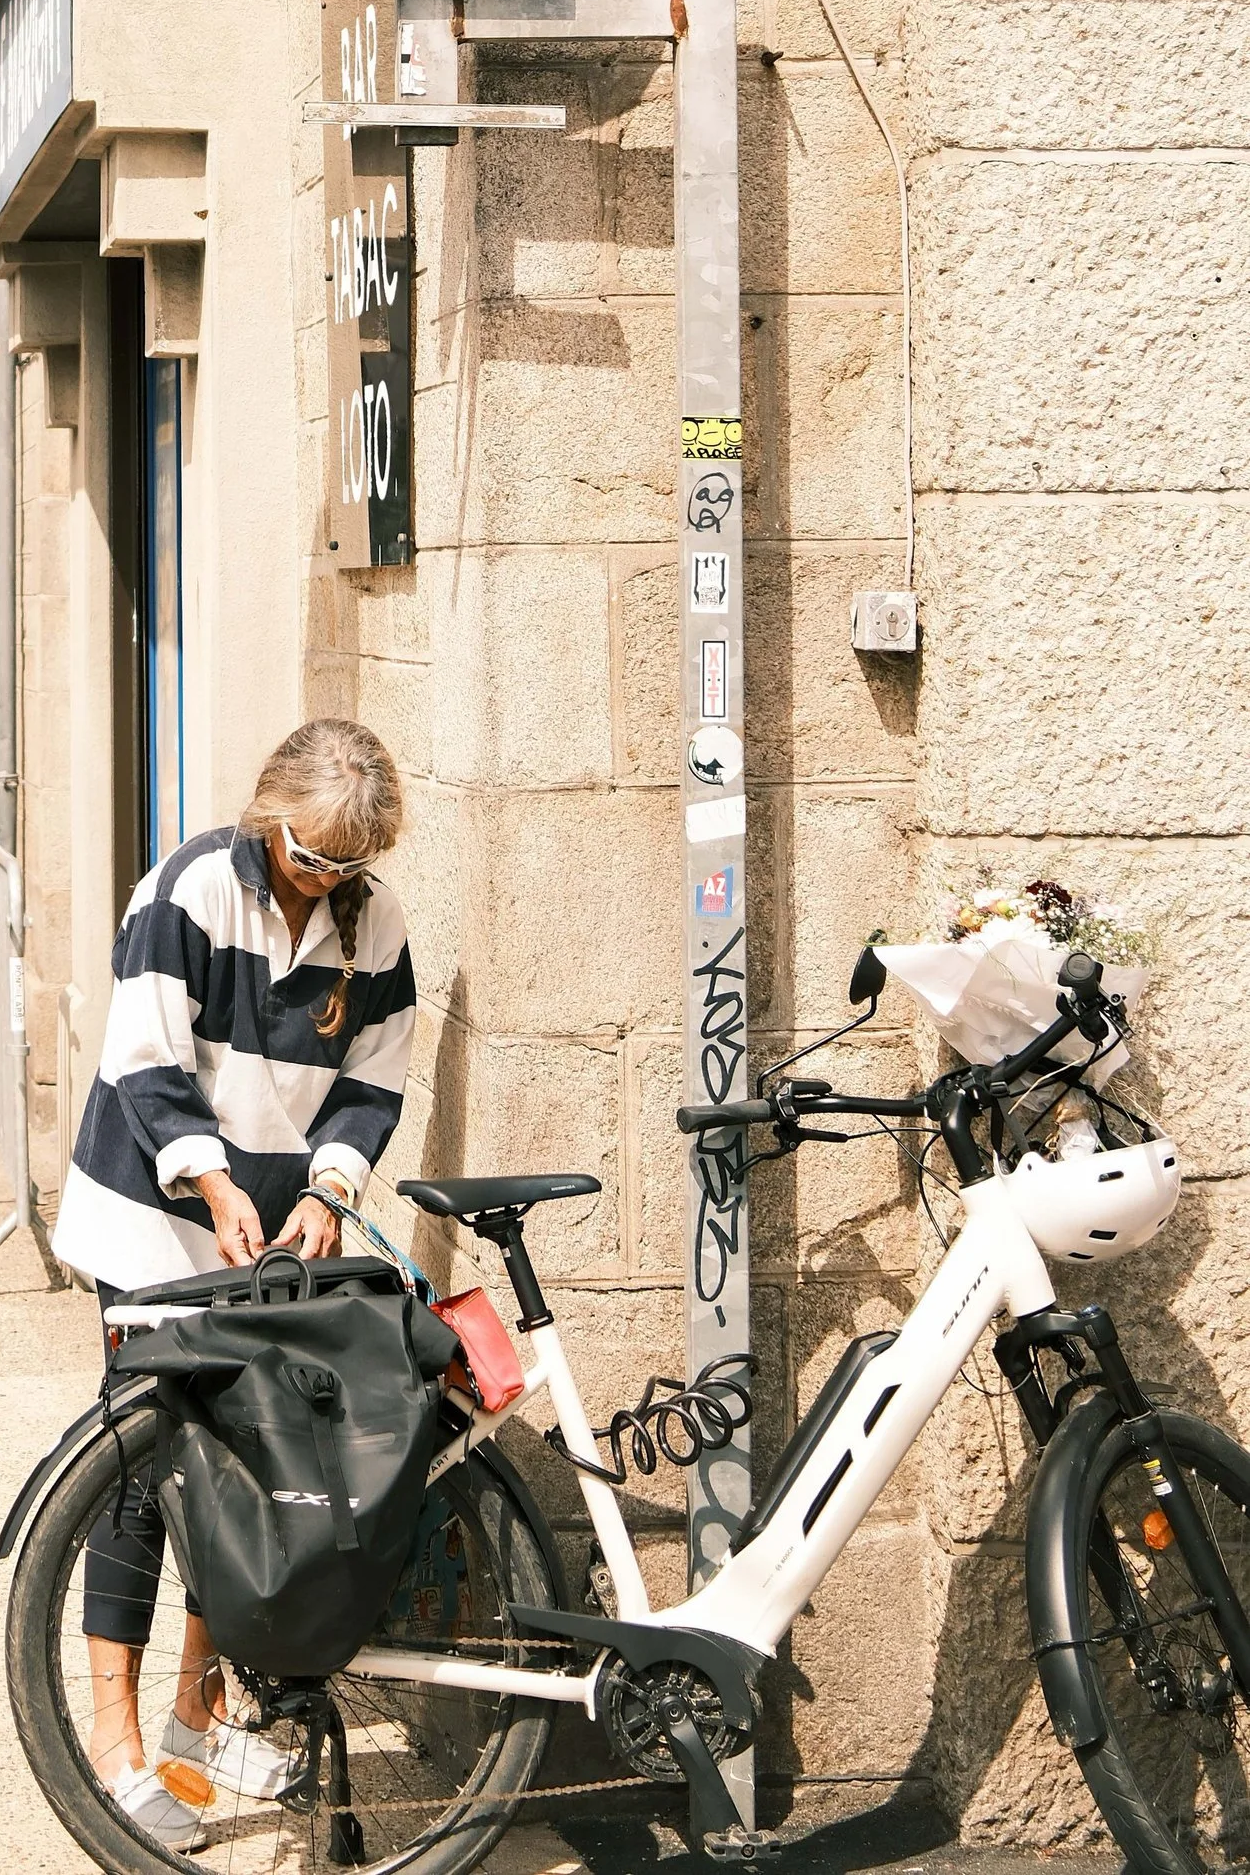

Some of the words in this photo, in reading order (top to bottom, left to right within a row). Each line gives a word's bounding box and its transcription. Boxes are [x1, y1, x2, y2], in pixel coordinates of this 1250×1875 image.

[341, 3, 378, 142] BAR
[331, 181, 399, 325] TABAC
[341, 378, 392, 505] LOTO
[704, 876, 726, 896] AZ
